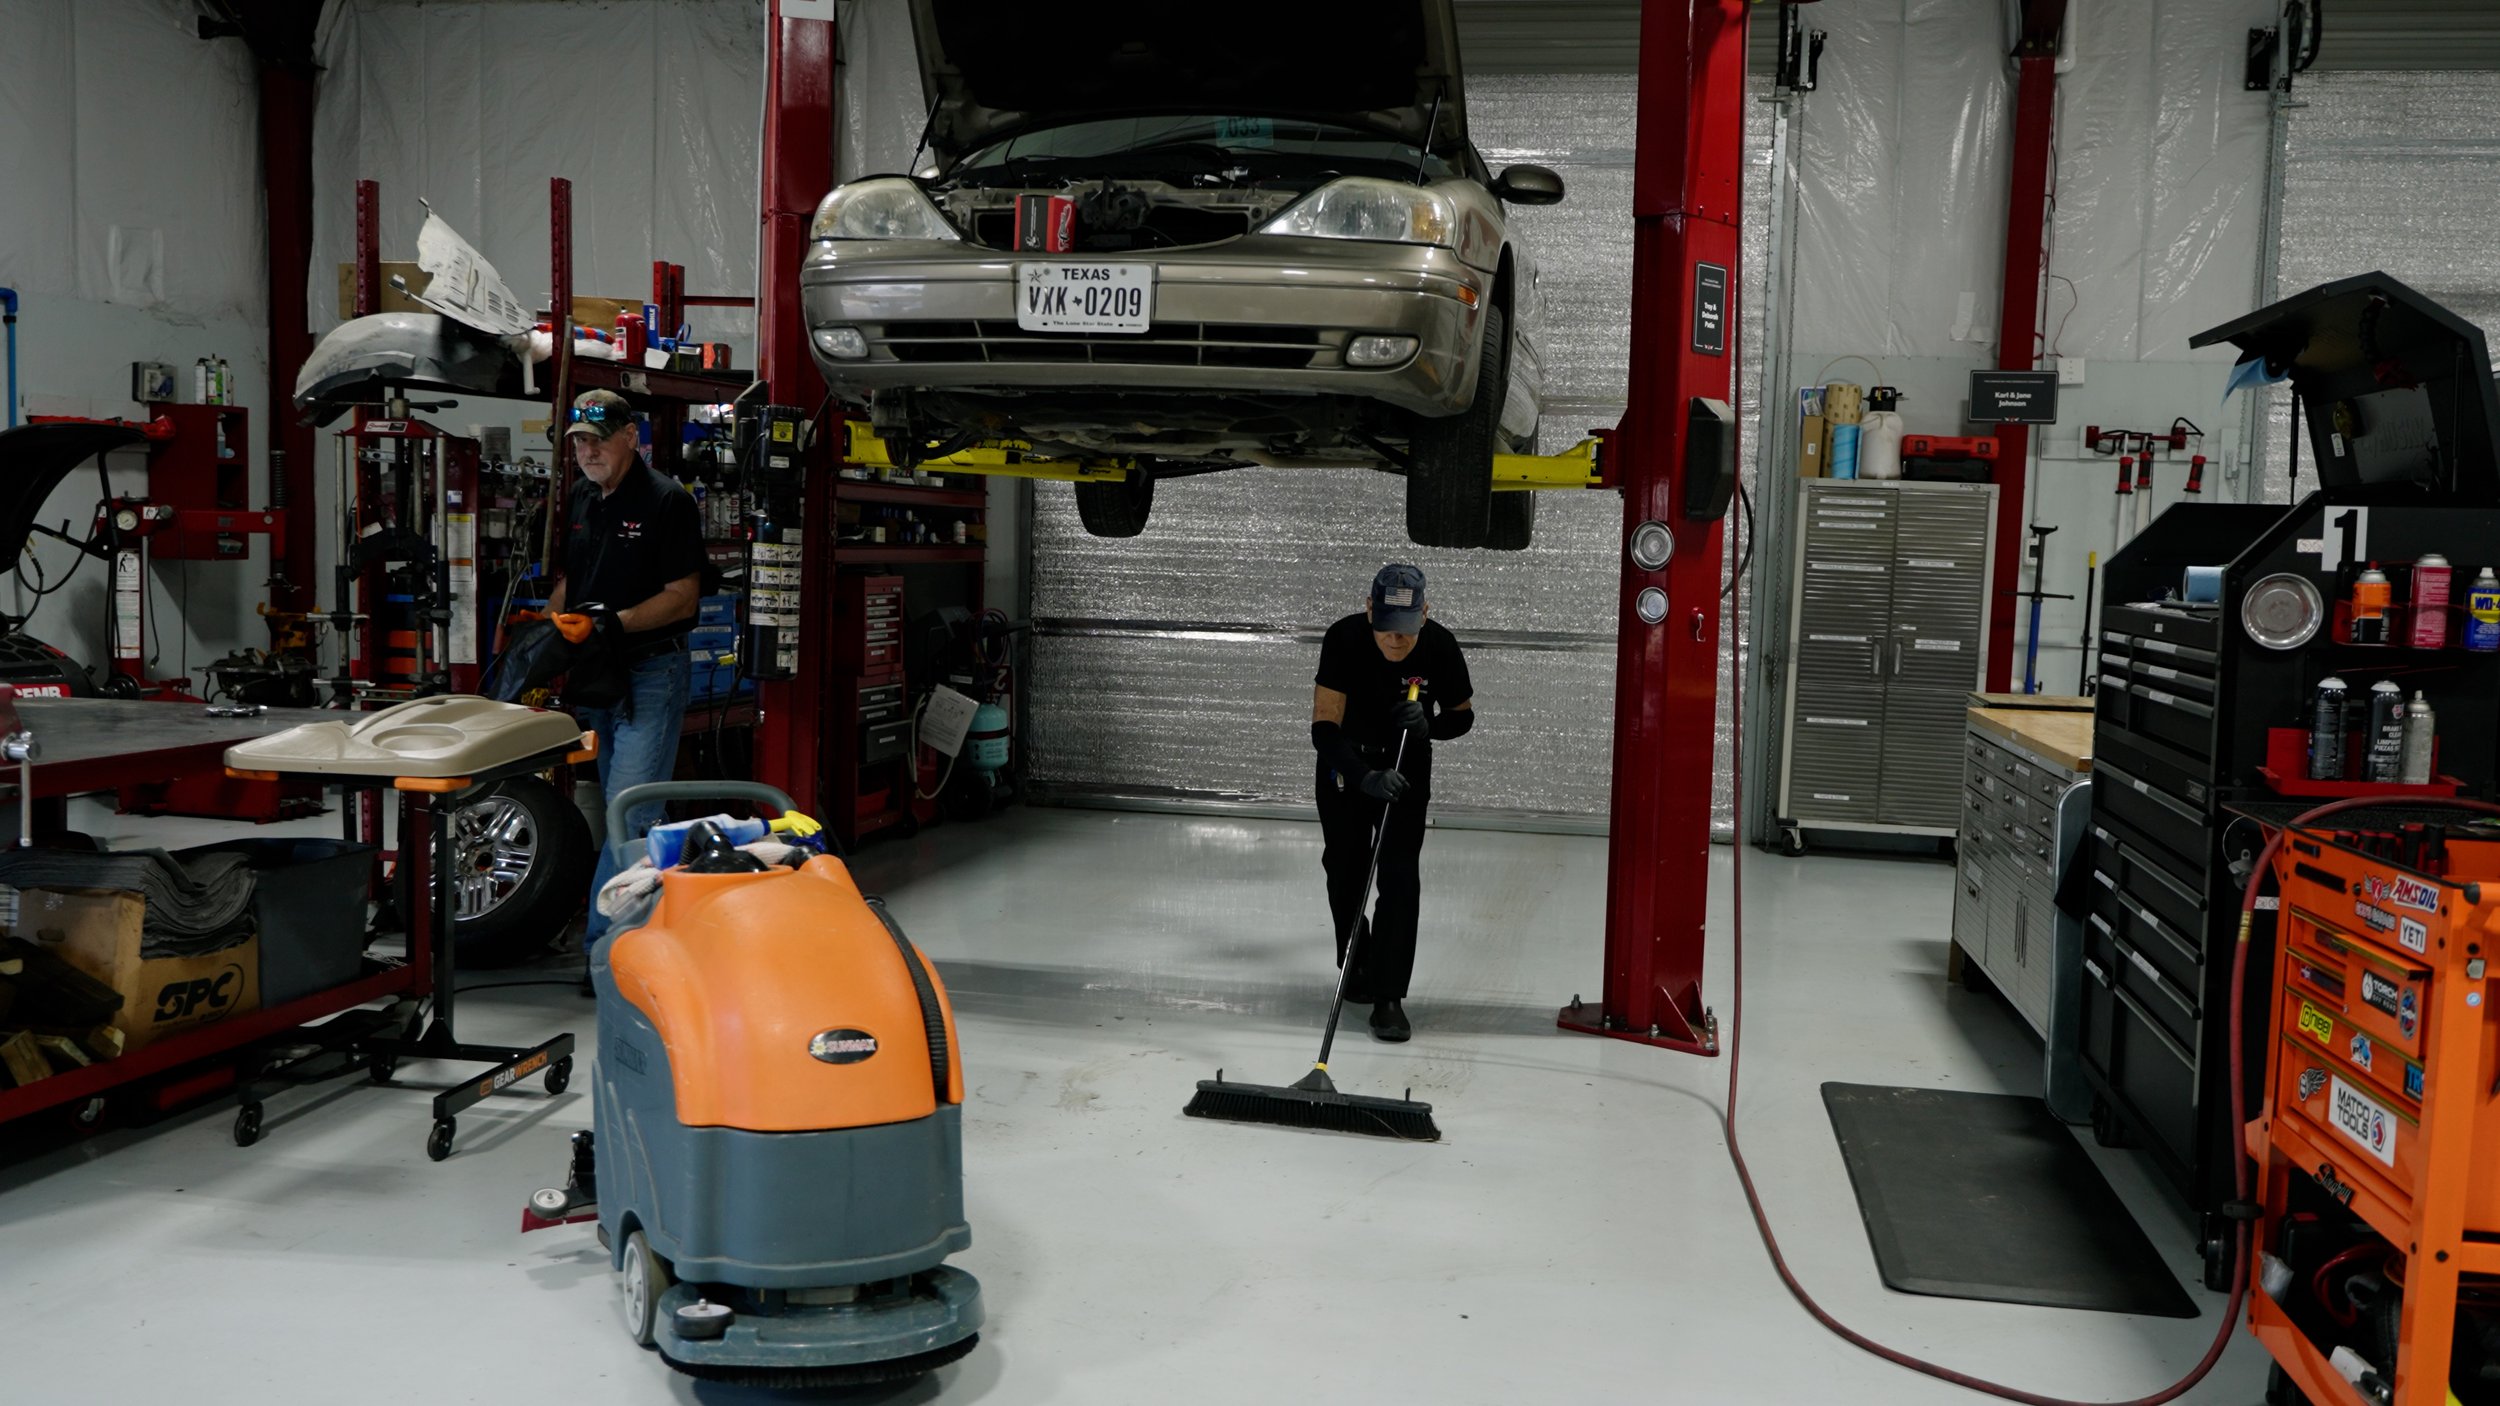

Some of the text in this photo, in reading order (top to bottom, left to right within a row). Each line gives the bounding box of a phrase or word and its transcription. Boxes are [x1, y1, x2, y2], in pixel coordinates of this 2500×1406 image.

[1062, 268, 1110, 281] TEXAS
[1029, 286, 1141, 317] VXK 0209
[1998, 400, 2027, 408] Johnson
[2016, 391, 2032, 399] Jane
[2334, 509, 2358, 564] 1
[2394, 877, 2438, 910] AMSOIL
[2402, 922, 2424, 951] YETI
[154, 971, 234, 1022] SPC
[2373, 980, 2398, 999] TORCH
[2338, 1087, 2370, 1122] MATCO
[2337, 1105, 2369, 1141] TOOLS
